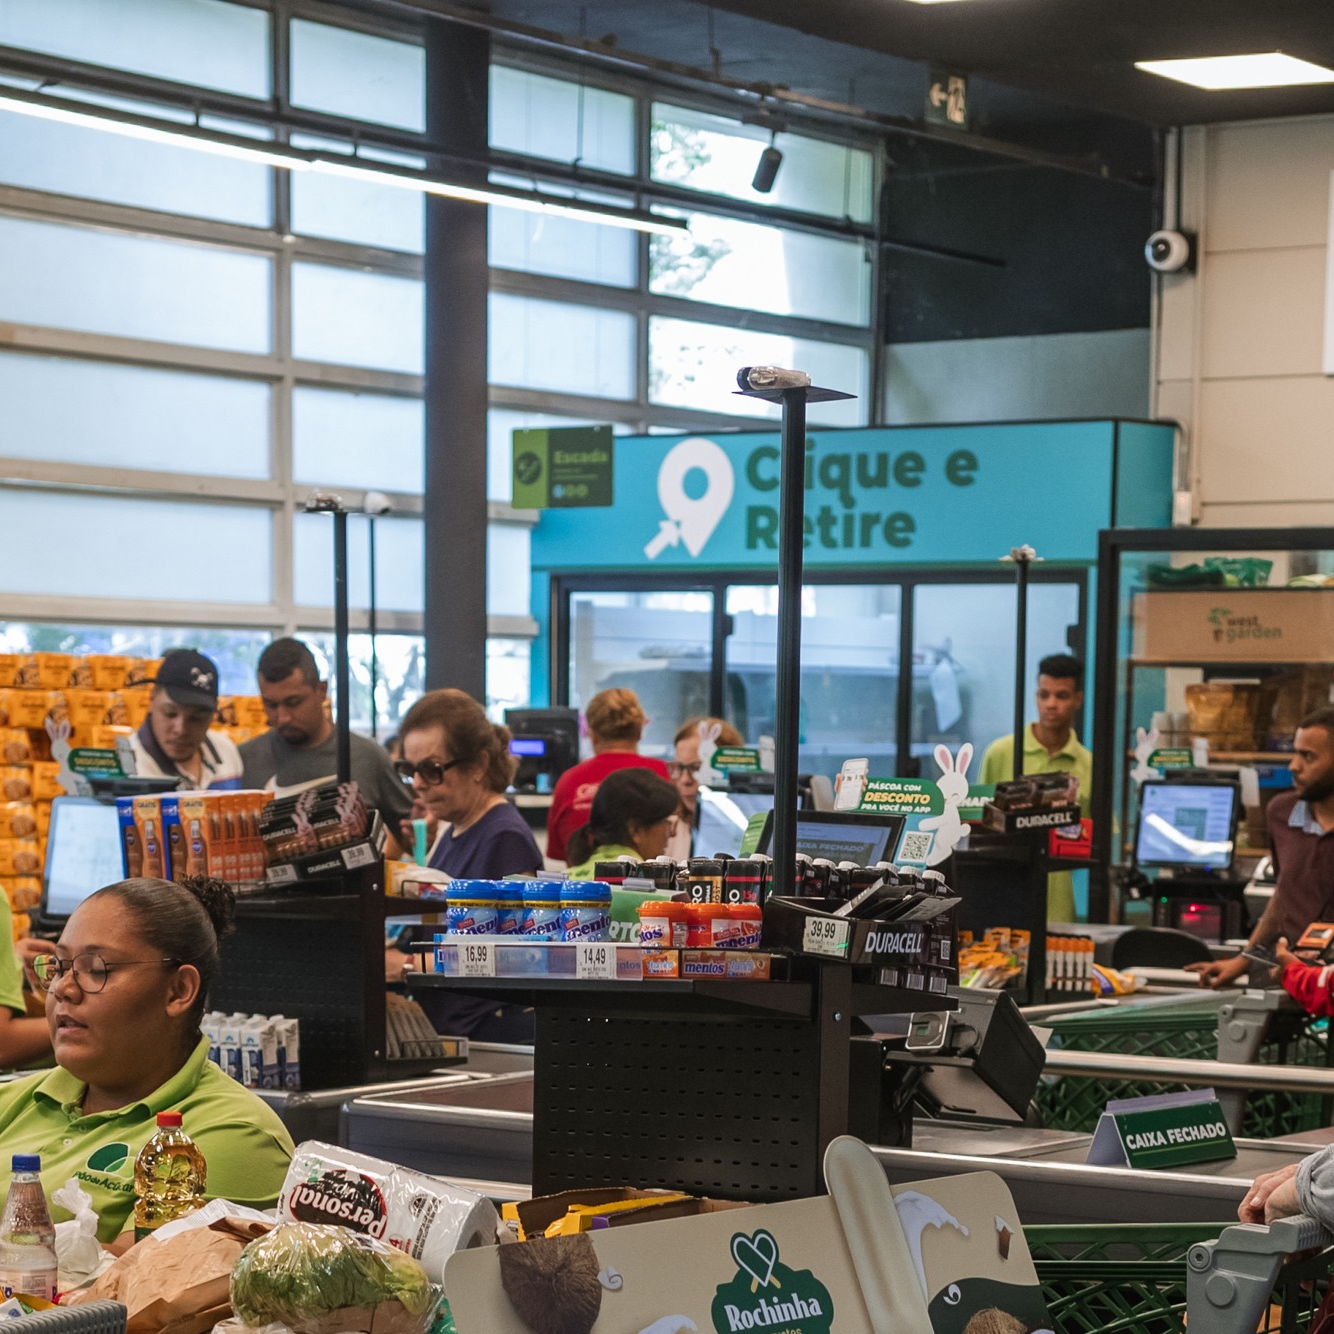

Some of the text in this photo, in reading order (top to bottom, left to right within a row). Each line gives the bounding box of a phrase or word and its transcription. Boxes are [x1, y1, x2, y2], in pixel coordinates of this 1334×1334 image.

[745, 439, 979, 509] Cique e
[868, 781, 922, 792] PÁSCOA COM
[864, 792, 931, 804] DESCONTO
[861, 803, 931, 814] PRA VOCÊ NO APP
[1016, 811, 1073, 828] DURACELL
[797, 842, 819, 850] AIXA
[810, 921, 836, 939] 39,99
[865, 931, 924, 954] DURACELL
[465, 946, 488, 964] 16,99
[583, 947, 606, 965] 14,49
[619, 960, 641, 969] ntos
[684, 961, 724, 974] mentos
[1126, 1122, 1227, 1150] CAIXA FECHADO
[292, 1185, 387, 1239] Personal
[724, 1292, 823, 1332] Rochinha
